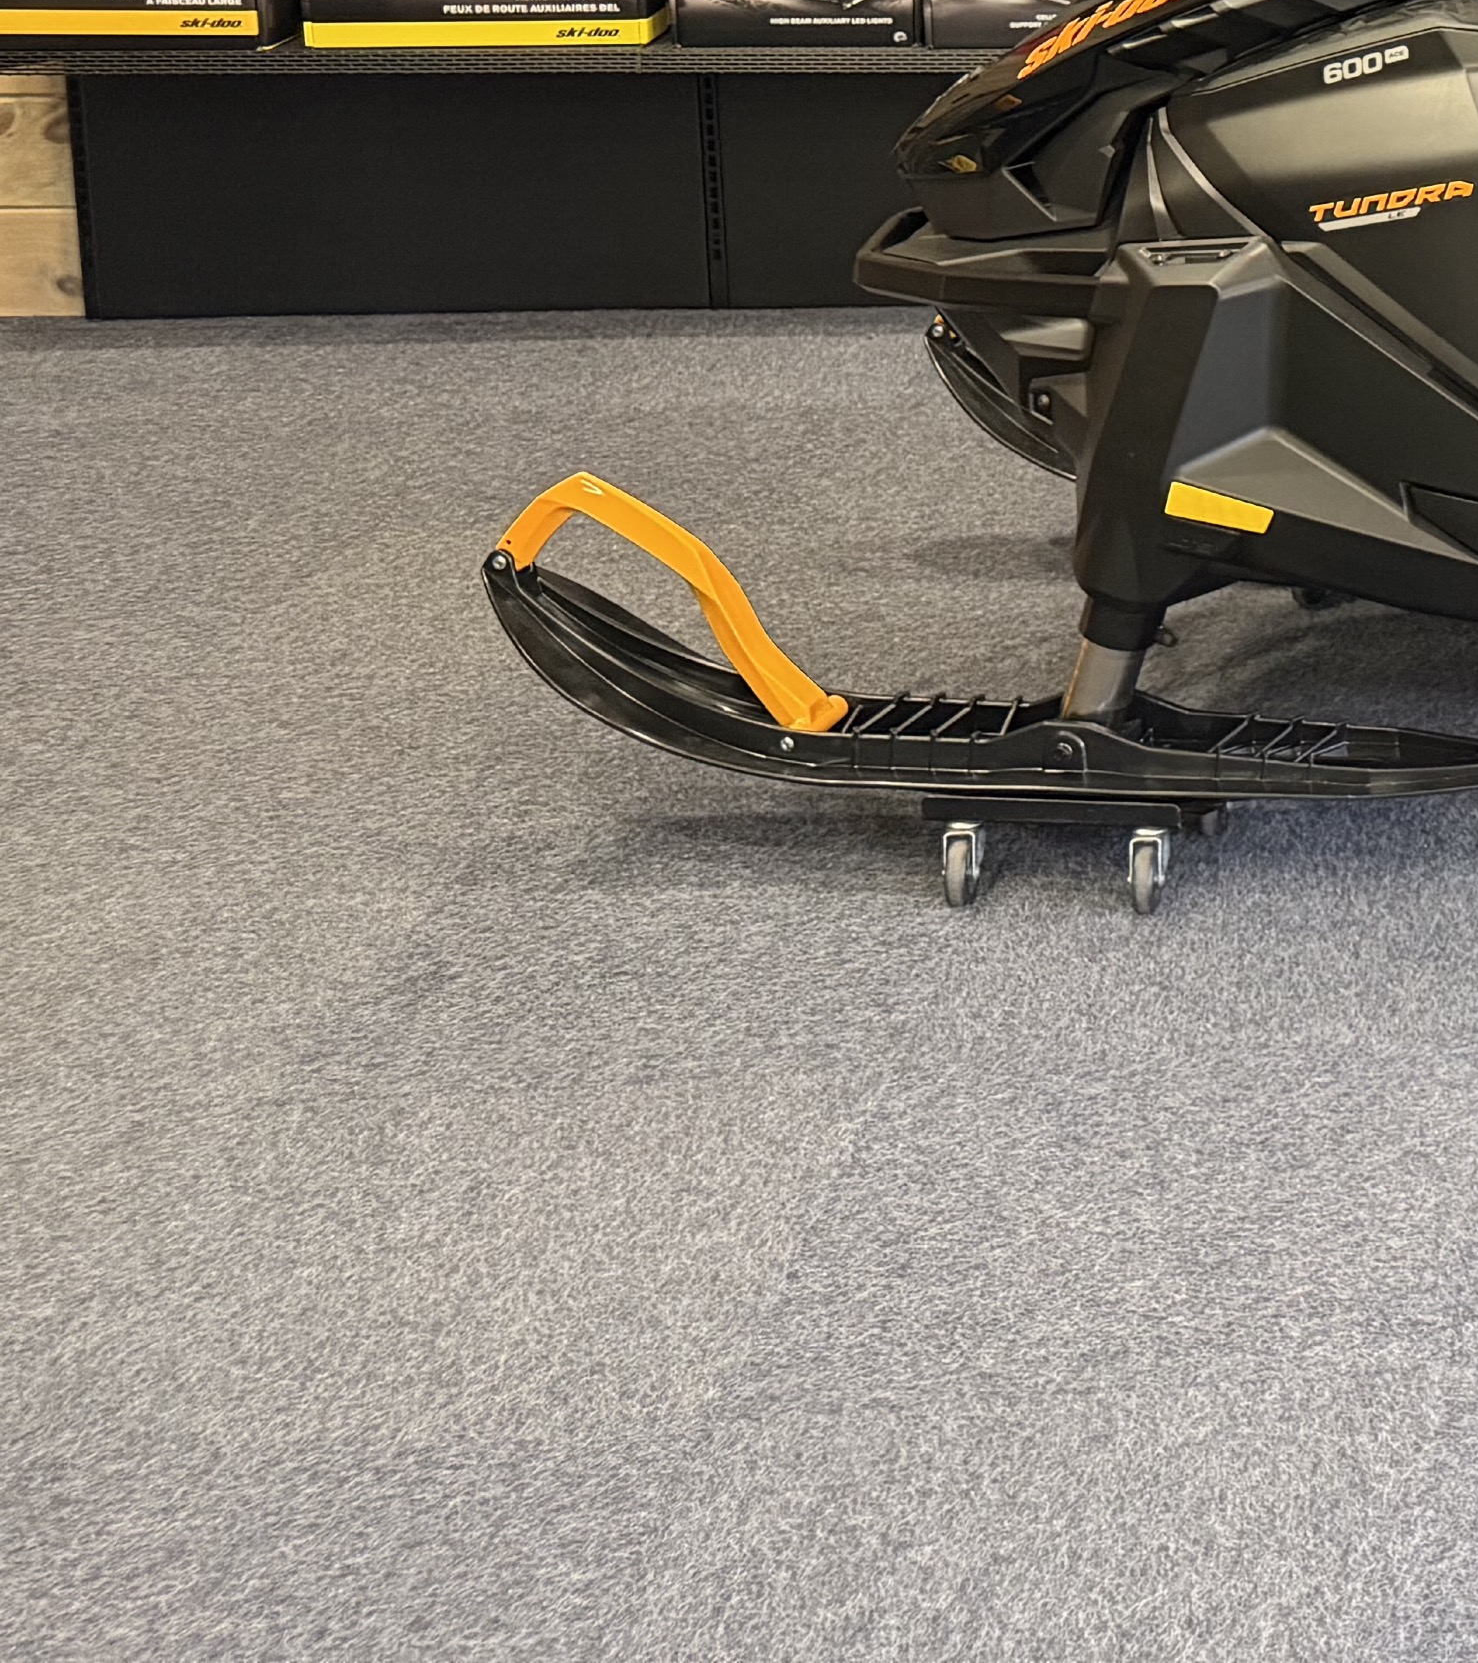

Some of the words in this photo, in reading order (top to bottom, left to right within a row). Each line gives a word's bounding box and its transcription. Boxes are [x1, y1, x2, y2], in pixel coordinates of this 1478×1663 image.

[443, 5, 473, 14] FEUX
[475, 5, 490, 14] DE
[492, 5, 529, 13] ROUTE
[530, 4, 597, 13] AUXILIAIRES
[599, 4, 620, 12] DEL
[180, 18, 242, 28] ski-doo
[556, 27, 620, 38] ski-doo
[1323, 51, 1383, 85] 600
[1308, 180, 1474, 222] TUNDRA
